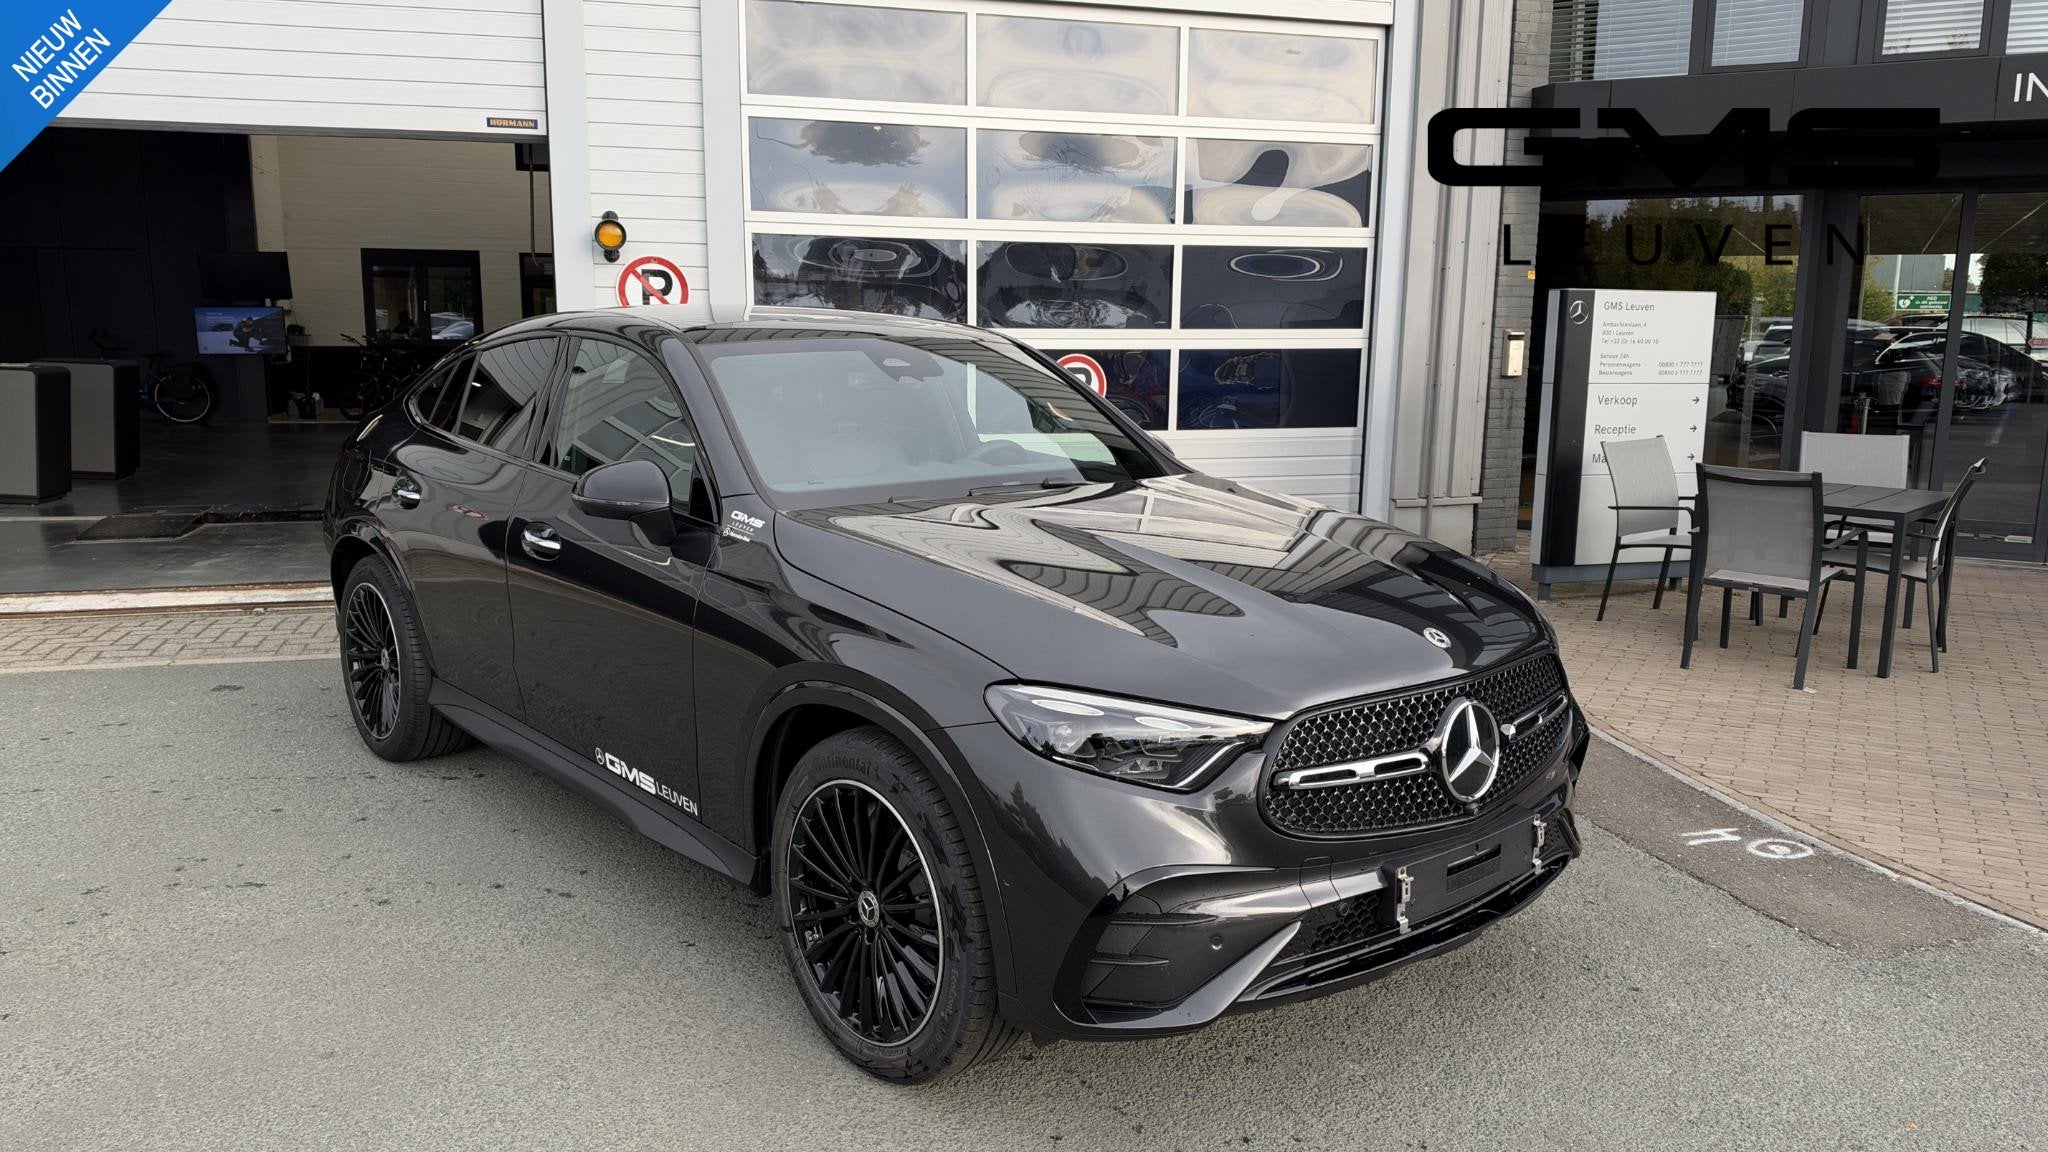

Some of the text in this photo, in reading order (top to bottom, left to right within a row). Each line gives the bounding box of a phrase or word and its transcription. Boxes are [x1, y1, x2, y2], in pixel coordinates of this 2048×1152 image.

[1603, 301, 1655, 312] GMS Leuven
[1597, 395, 1638, 407] Verkoop
[1594, 424, 1637, 436] Receptie
[731, 510, 766, 528] GMS
[604, 752, 698, 816] GMS LEUVEN
